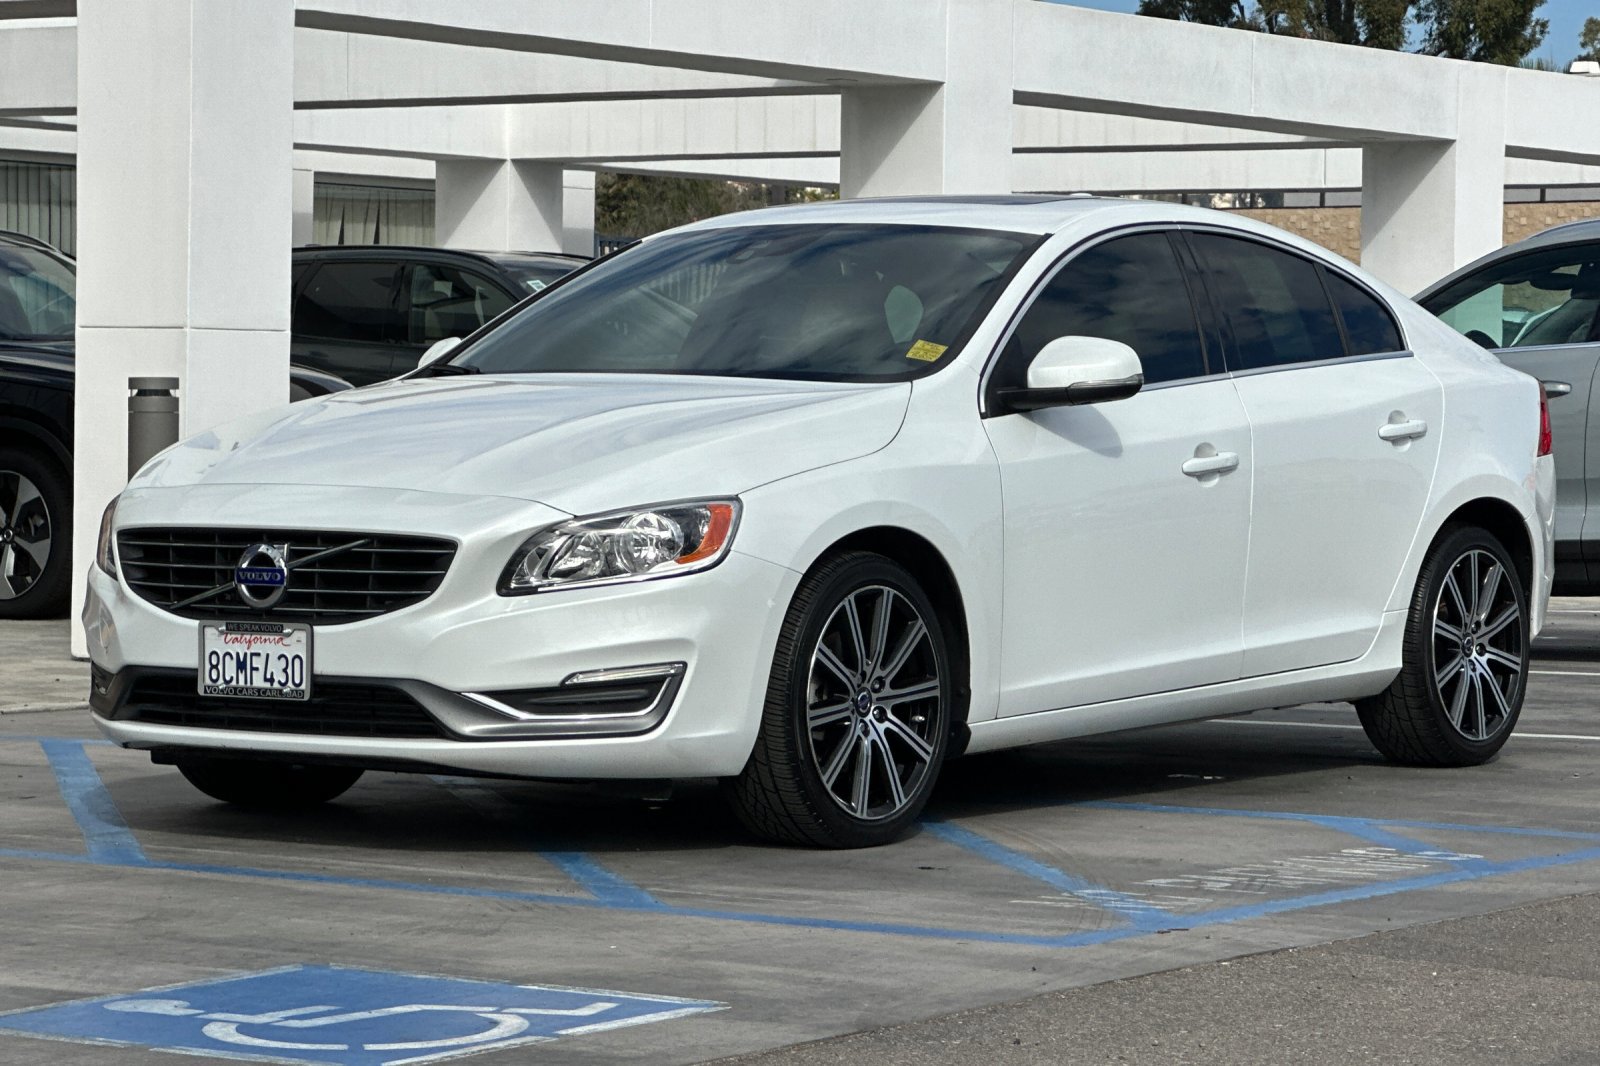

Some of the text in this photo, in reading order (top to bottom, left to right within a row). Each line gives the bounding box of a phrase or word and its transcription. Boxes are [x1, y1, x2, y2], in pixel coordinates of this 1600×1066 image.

[238, 571, 281, 581] VOLVO
[240, 624, 260, 632] SPEAK
[261, 625, 282, 633] VOLVO
[224, 632, 291, 650] California
[208, 650, 304, 688] 8CMF430
[236, 687, 259, 696] CARS
